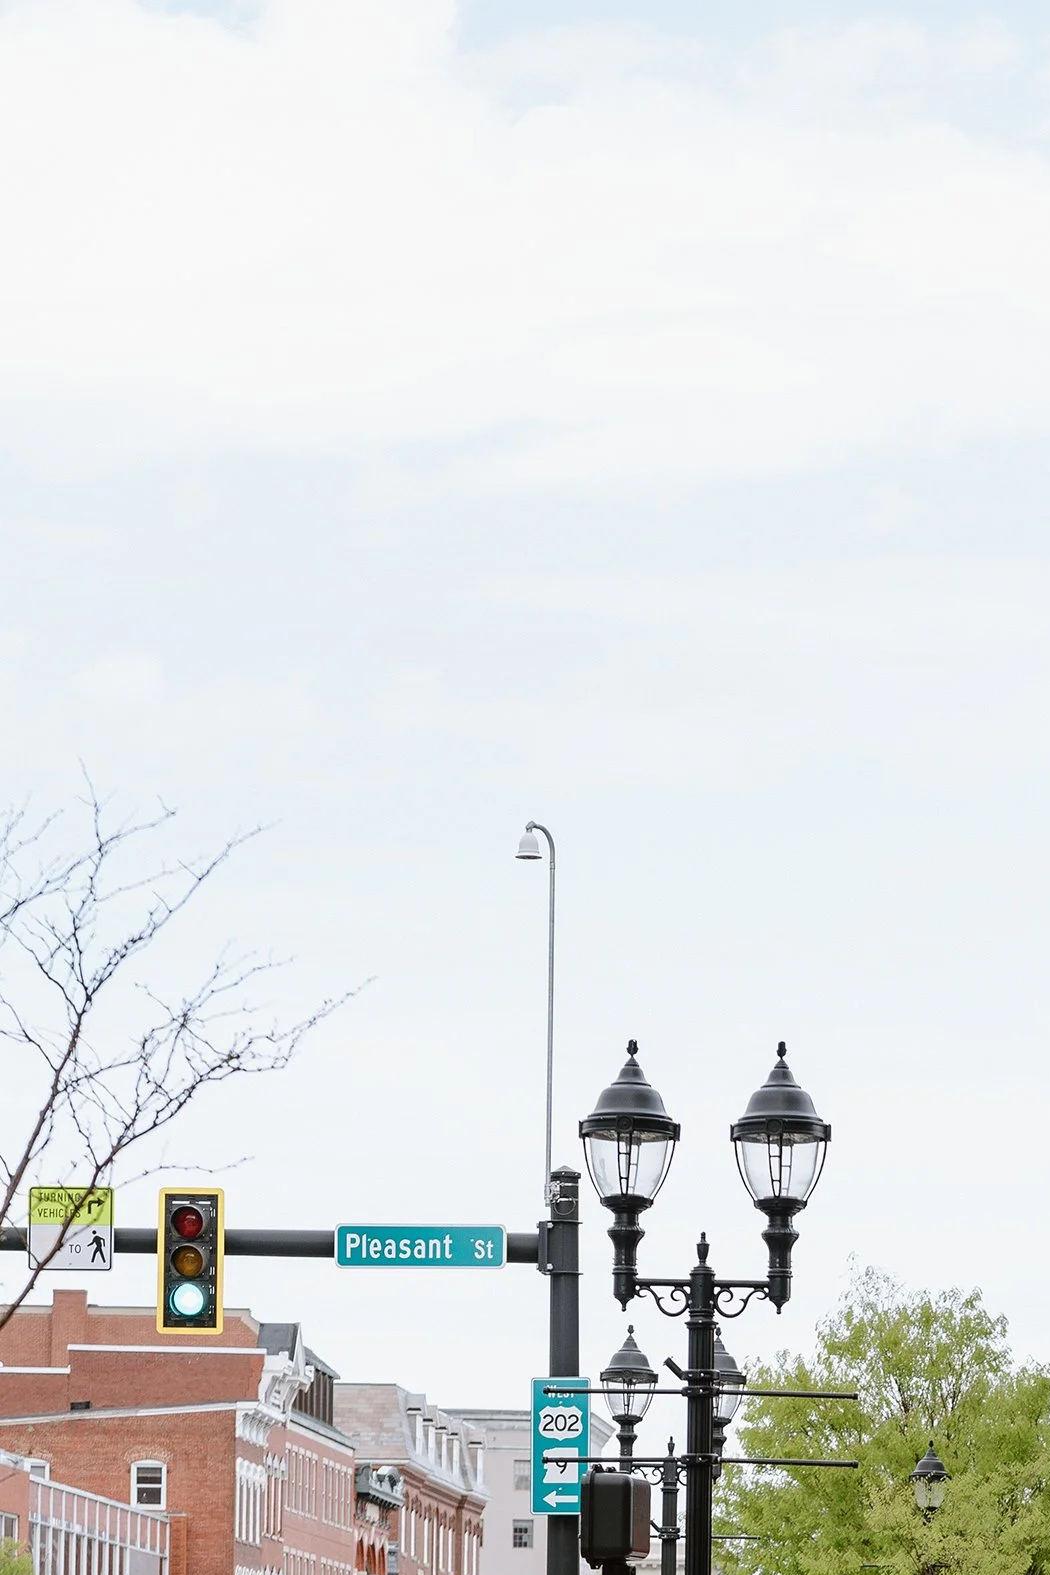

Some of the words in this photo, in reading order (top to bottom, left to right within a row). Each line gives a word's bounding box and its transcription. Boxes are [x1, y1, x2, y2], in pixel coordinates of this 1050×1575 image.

[38, 1208, 81, 1218] VEHICES
[69, 1244, 81, 1254] TO
[346, 1233, 453, 1259] Pleasant
[473, 1239, 494, 1259] St
[542, 1414, 579, 1432] 202
